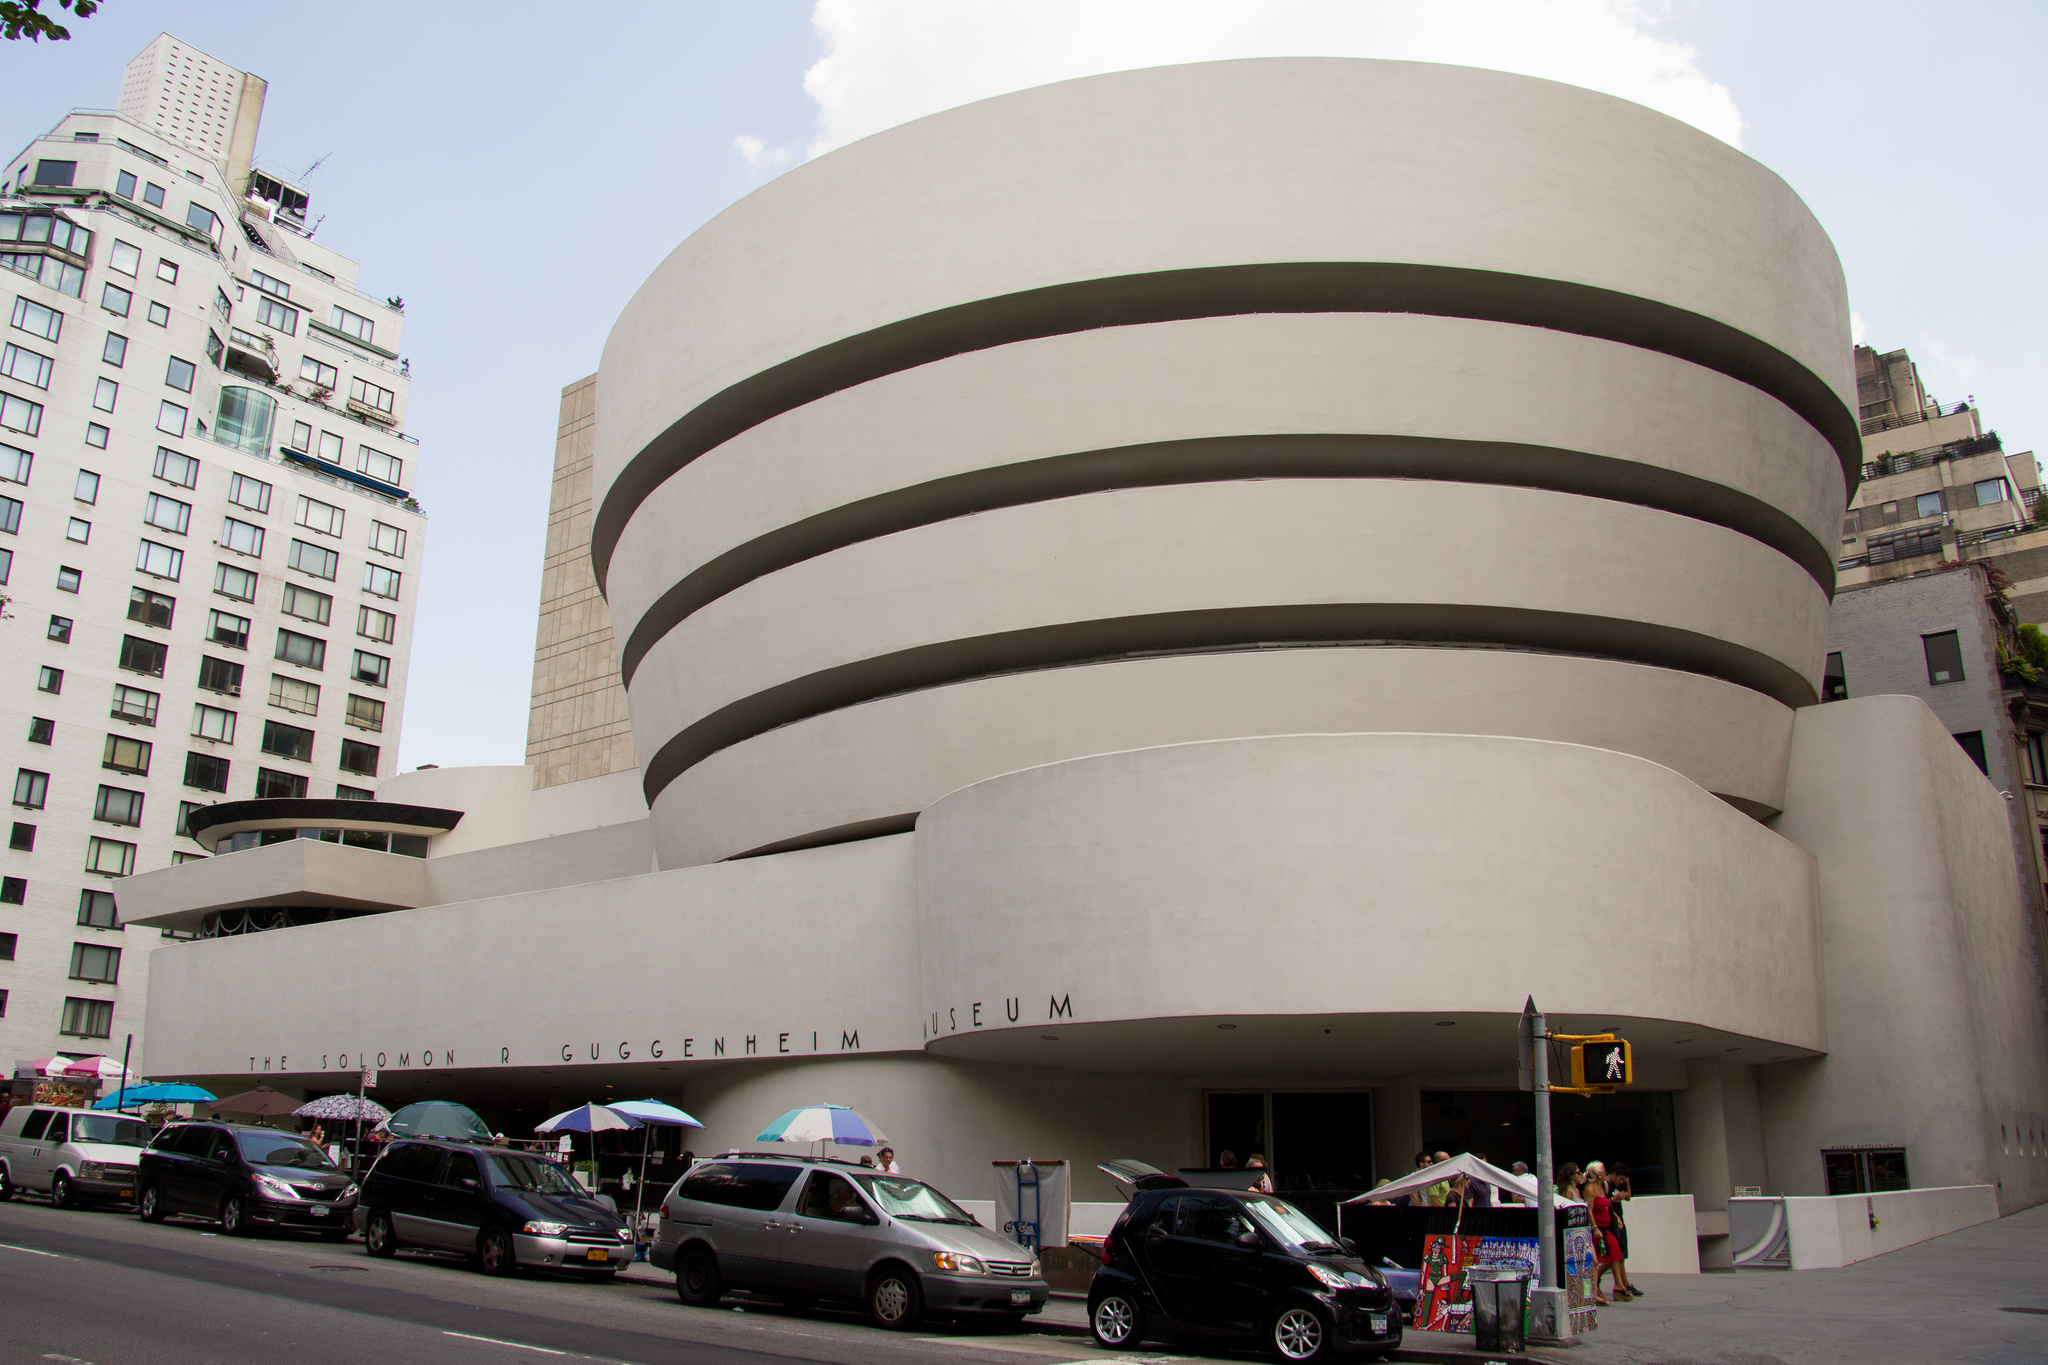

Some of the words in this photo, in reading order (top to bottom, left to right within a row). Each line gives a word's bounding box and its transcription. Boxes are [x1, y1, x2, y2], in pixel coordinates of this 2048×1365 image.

[250, 1056, 287, 1071] THE
[323, 1050, 454, 1069] SOLOMON
[501, 1047, 510, 1064] R
[561, 1029, 861, 1062] GUGGENHEIM
